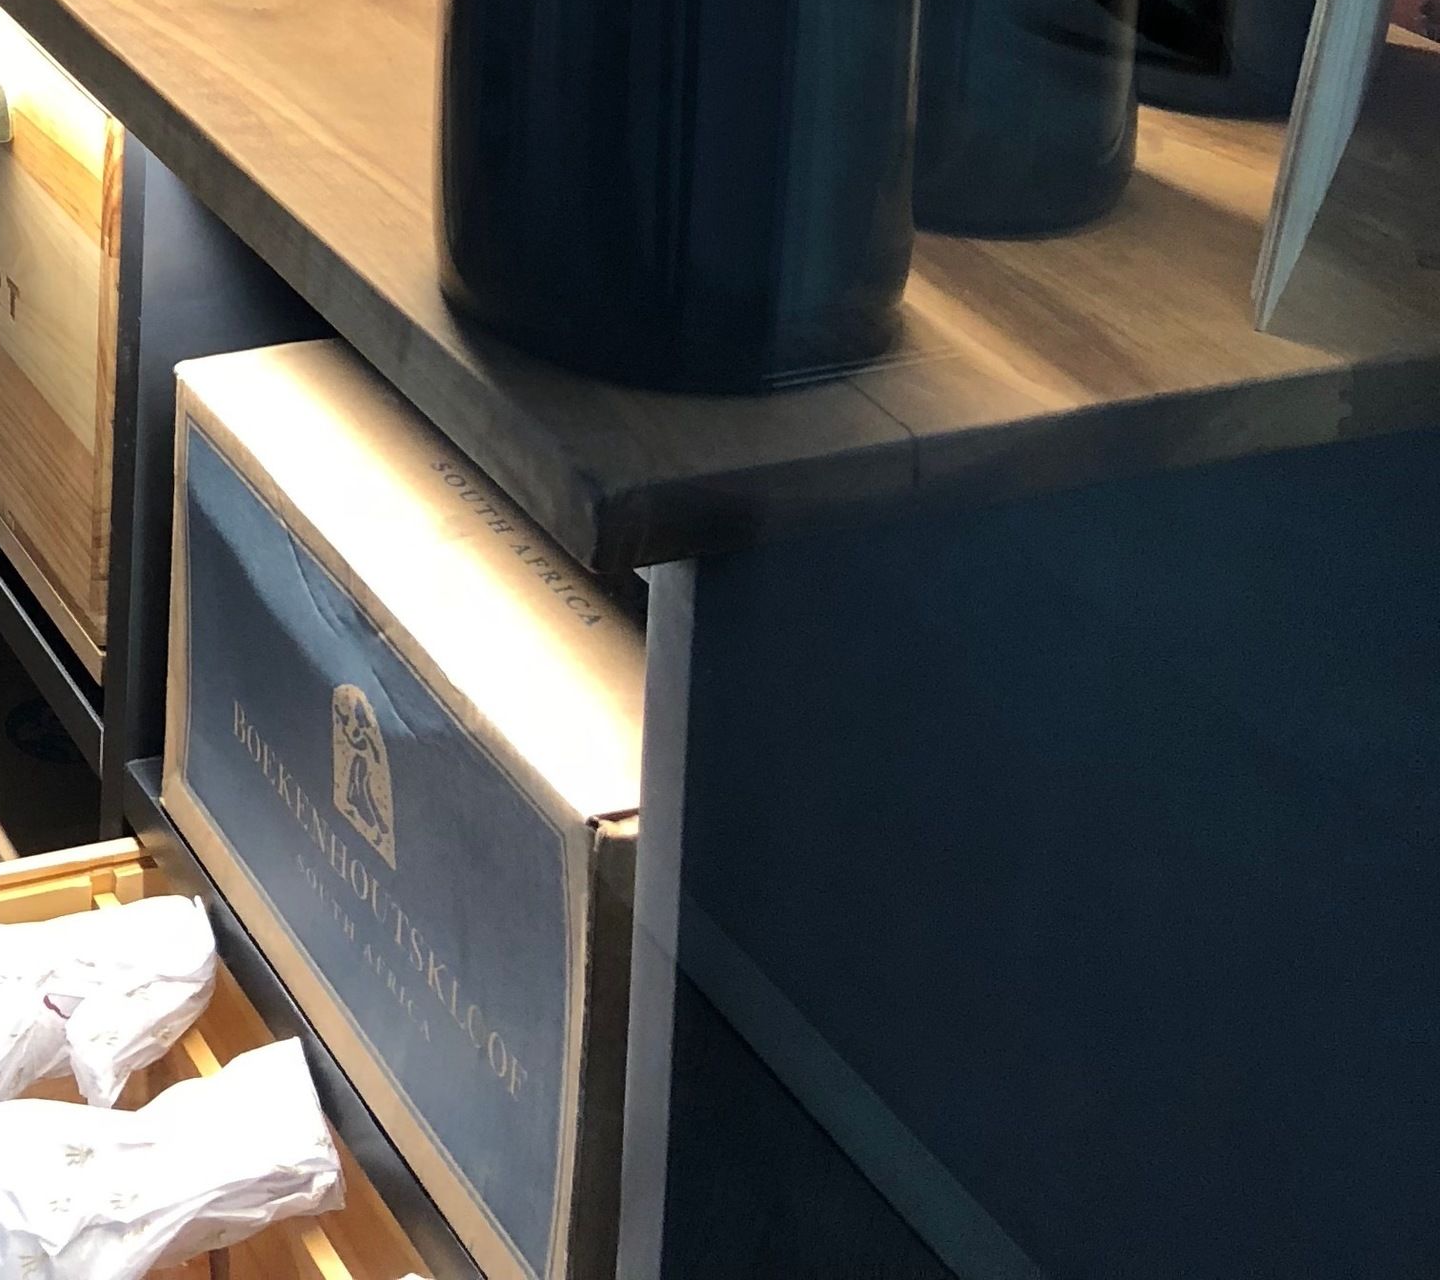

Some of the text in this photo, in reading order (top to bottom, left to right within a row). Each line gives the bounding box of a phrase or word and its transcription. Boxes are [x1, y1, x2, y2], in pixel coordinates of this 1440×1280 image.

[431, 459, 603, 627] SOUTH AFRICA
[232, 699, 528, 1100] BOEKENHOUTSKLOOF
[296, 853, 355, 942] SOUTH
